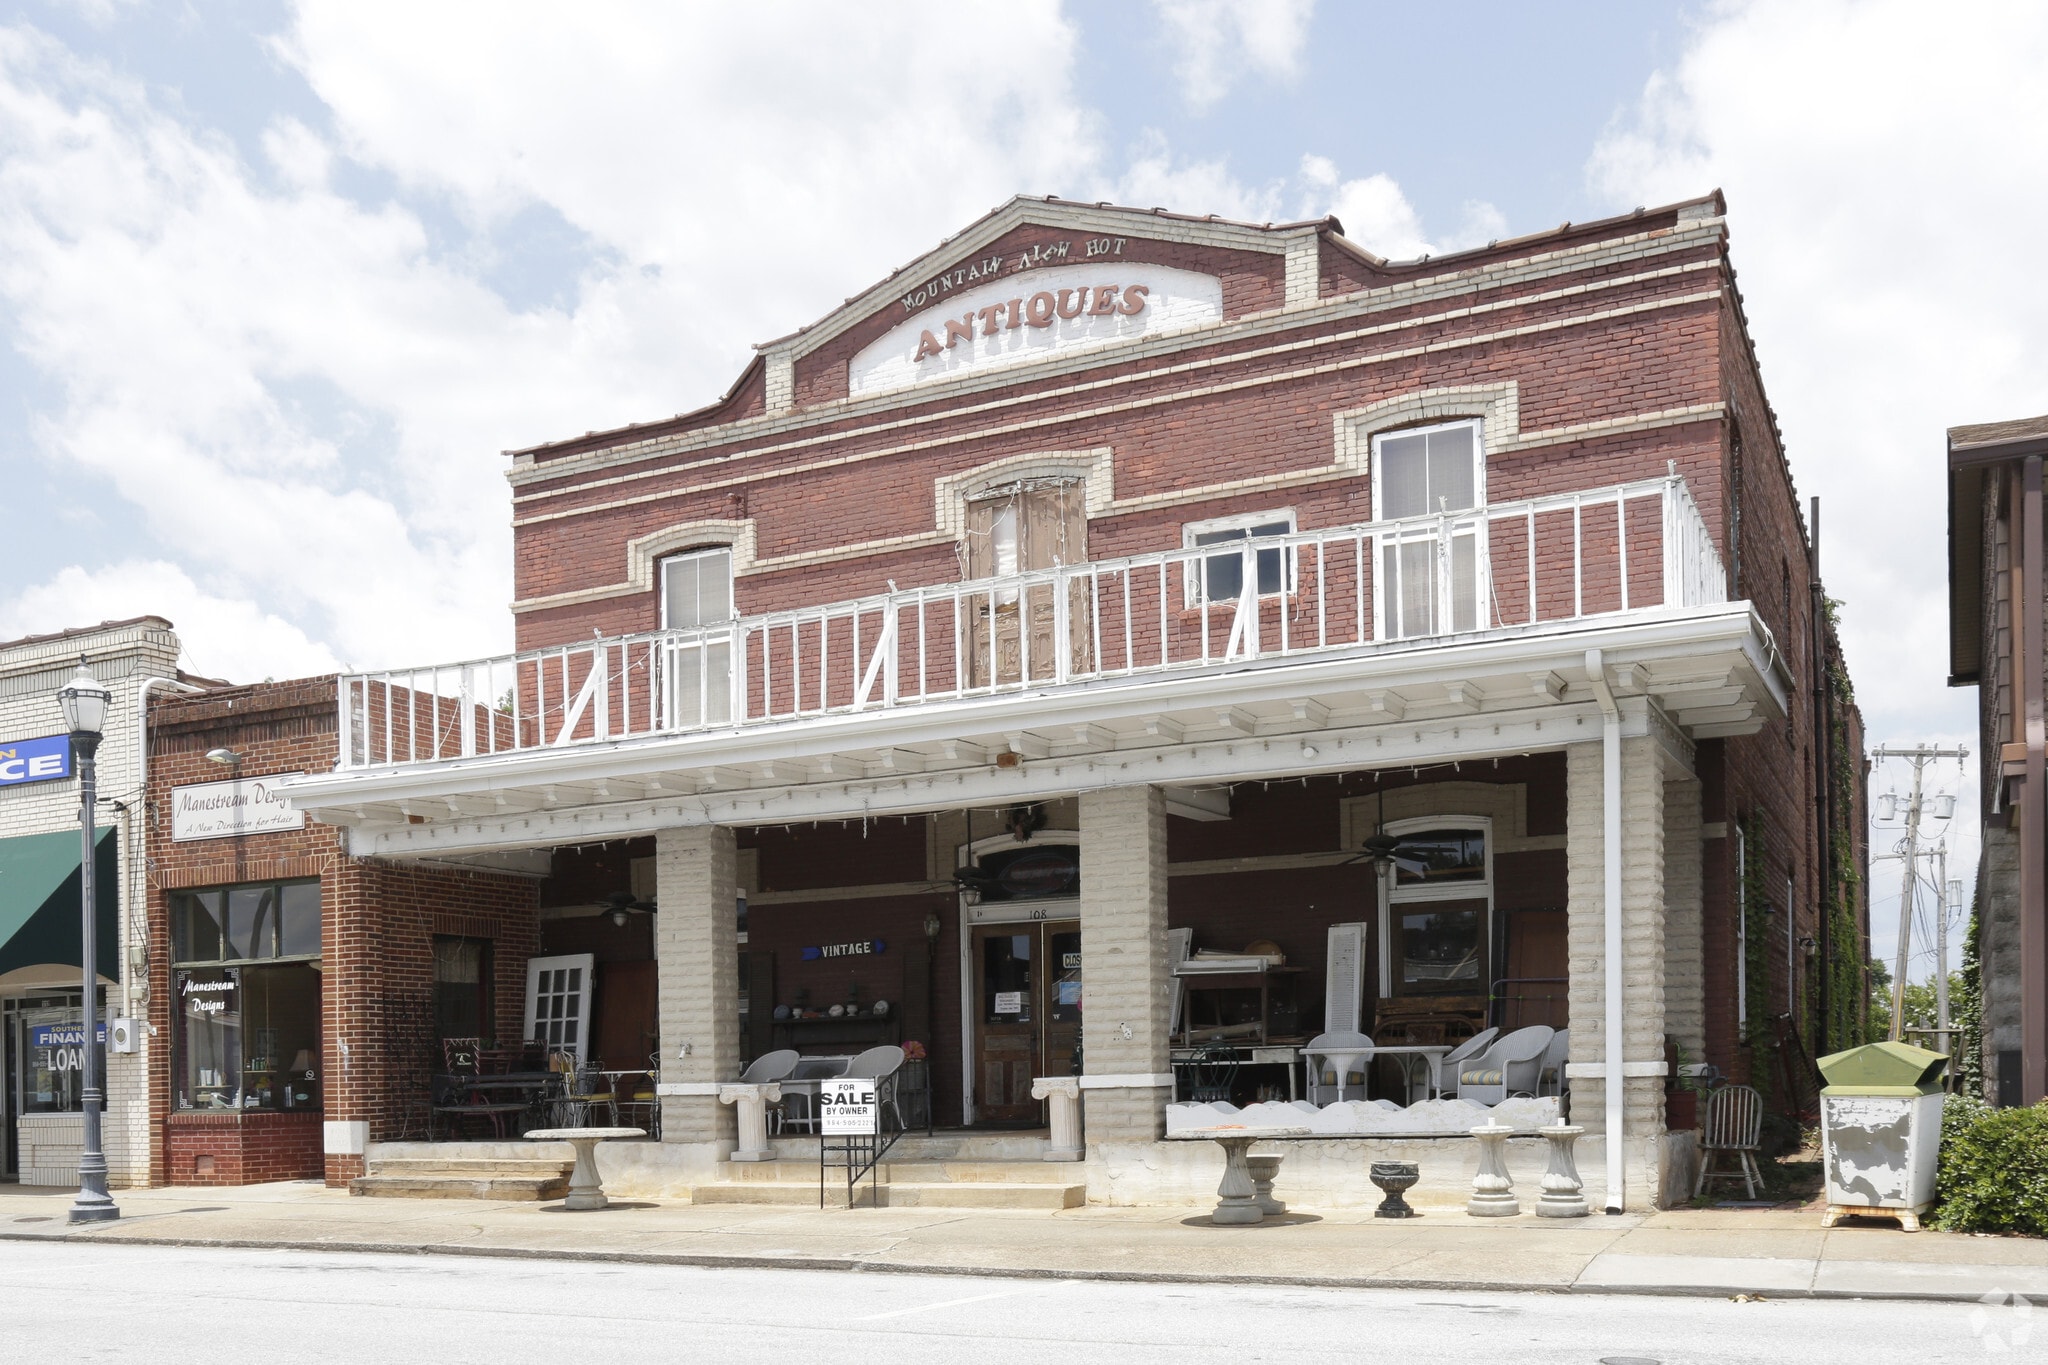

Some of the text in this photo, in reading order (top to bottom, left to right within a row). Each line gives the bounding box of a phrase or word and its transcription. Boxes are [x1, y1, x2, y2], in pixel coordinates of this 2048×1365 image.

[901, 256, 1002, 313] MOUNTAIN
[1085, 238, 1127, 257] HOT
[913, 284, 1150, 363] ANTIQUES
[177, 792, 249, 818] Manestream
[184, 814, 293, 836] A New Direction for Hair
[1029, 908, 1047, 920] 108
[822, 941, 871, 958] VINTAGE
[1064, 954, 1082, 967] CLOS
[182, 979, 235, 996] Manestream
[192, 997, 225, 1015] Designs
[39, 1031, 106, 1045] FINANE
[820, 1092, 876, 1105] SALE
[826, 1106, 868, 1115] BY OWNER
